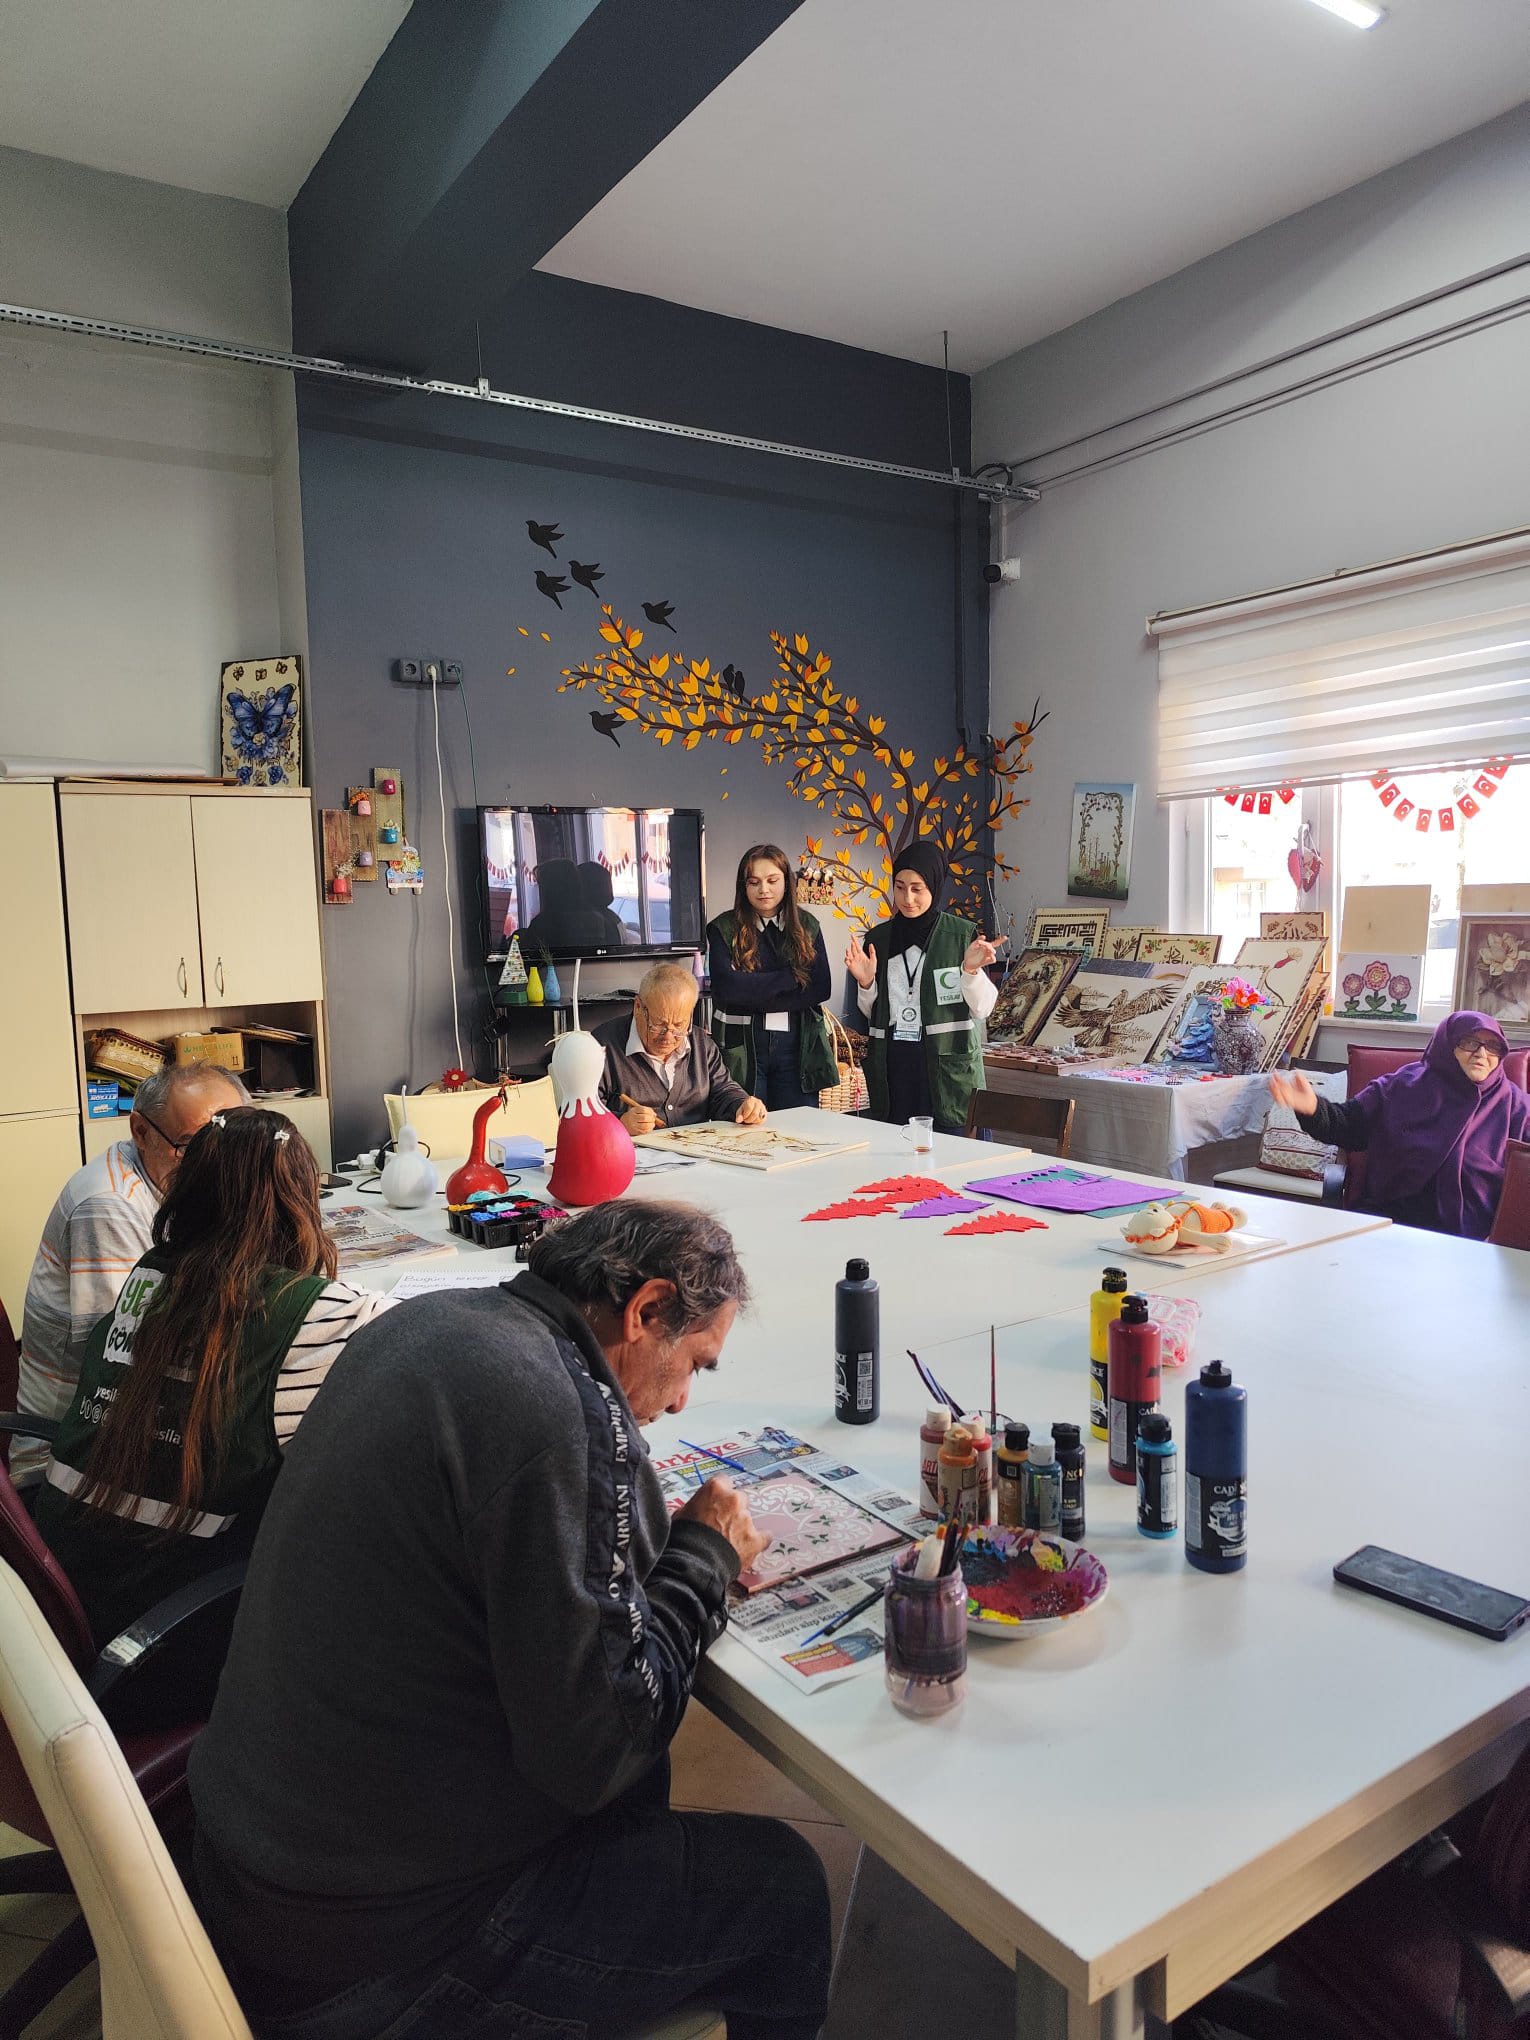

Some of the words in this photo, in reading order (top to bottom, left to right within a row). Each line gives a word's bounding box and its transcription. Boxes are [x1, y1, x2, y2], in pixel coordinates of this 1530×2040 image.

[121, 1278, 154, 1317] YE
[107, 1327, 133, 1353] GÖN
[616, 1484, 630, 1549] ARMANI
